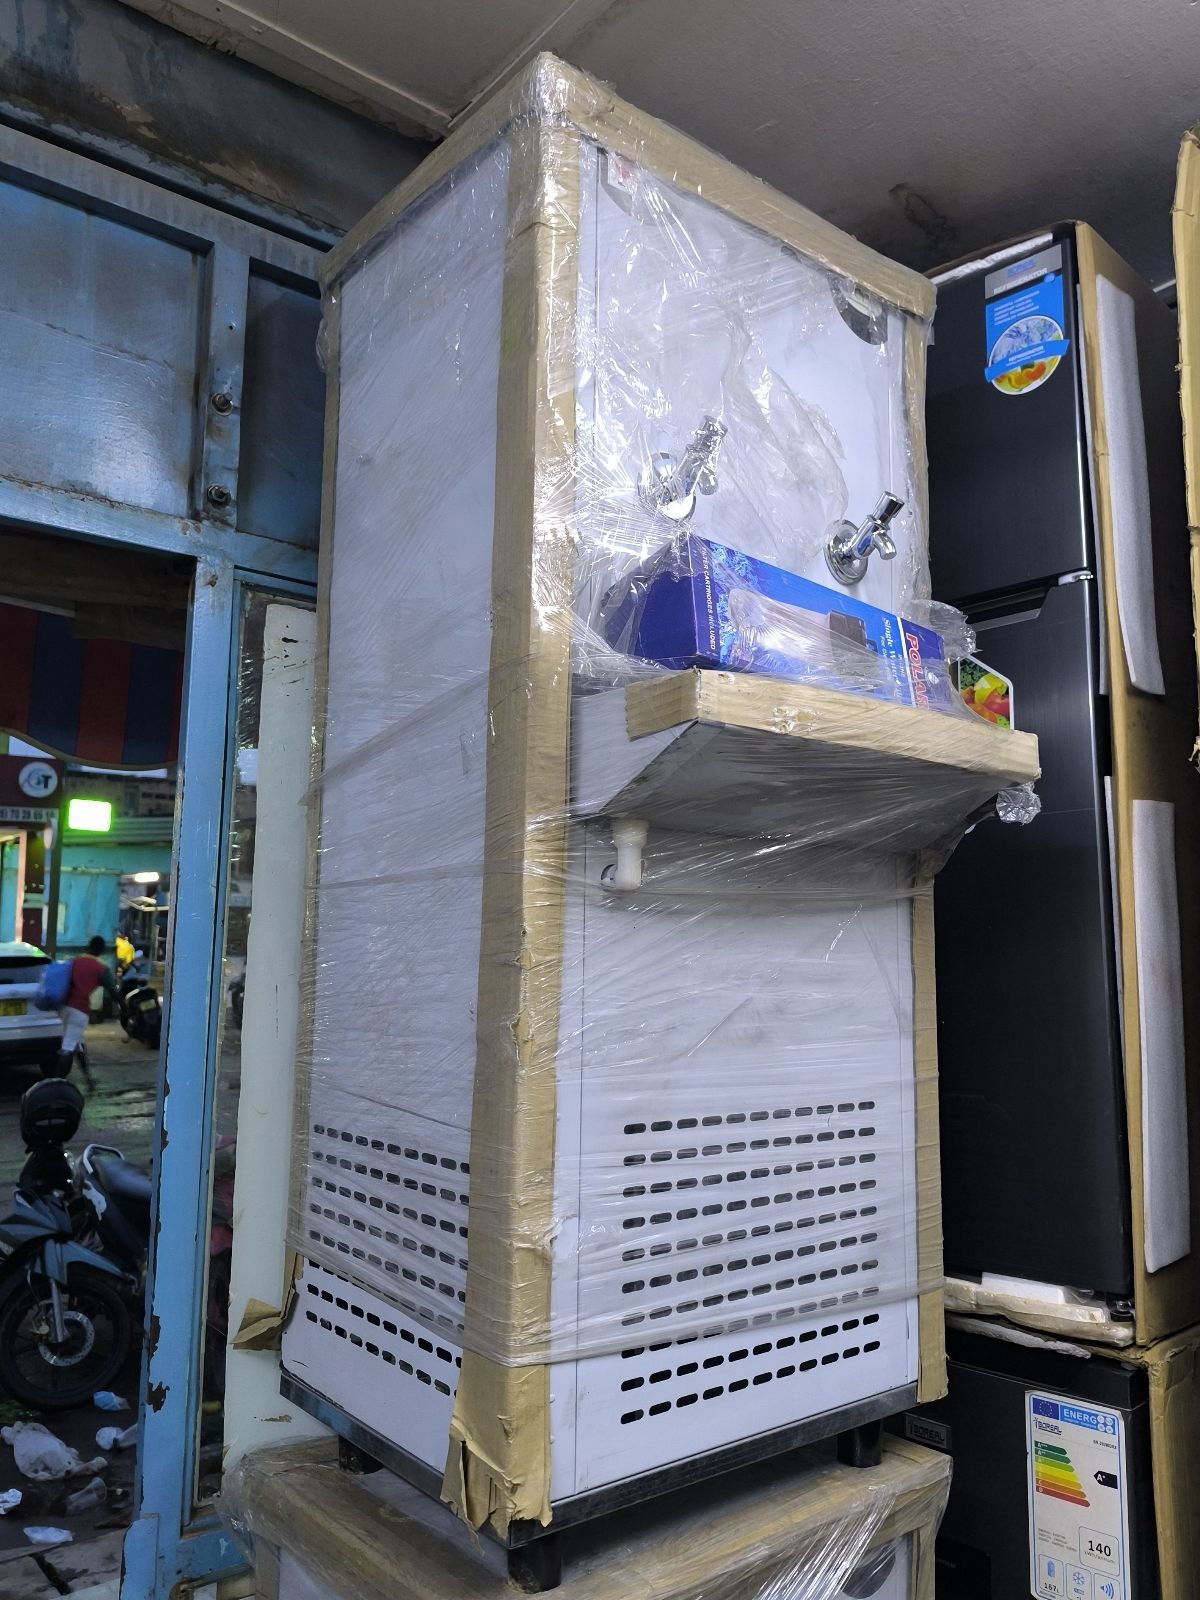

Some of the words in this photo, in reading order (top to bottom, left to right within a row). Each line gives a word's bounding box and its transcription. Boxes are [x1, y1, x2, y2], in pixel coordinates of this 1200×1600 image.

[704, 571, 713, 613] CARTRIDGES
[708, 614, 716, 650] INCLUDED
[883, 618, 894, 647] Single
[1063, 1409, 1097, 1424] ENERG
[1088, 1540, 1111, 1557] 140
